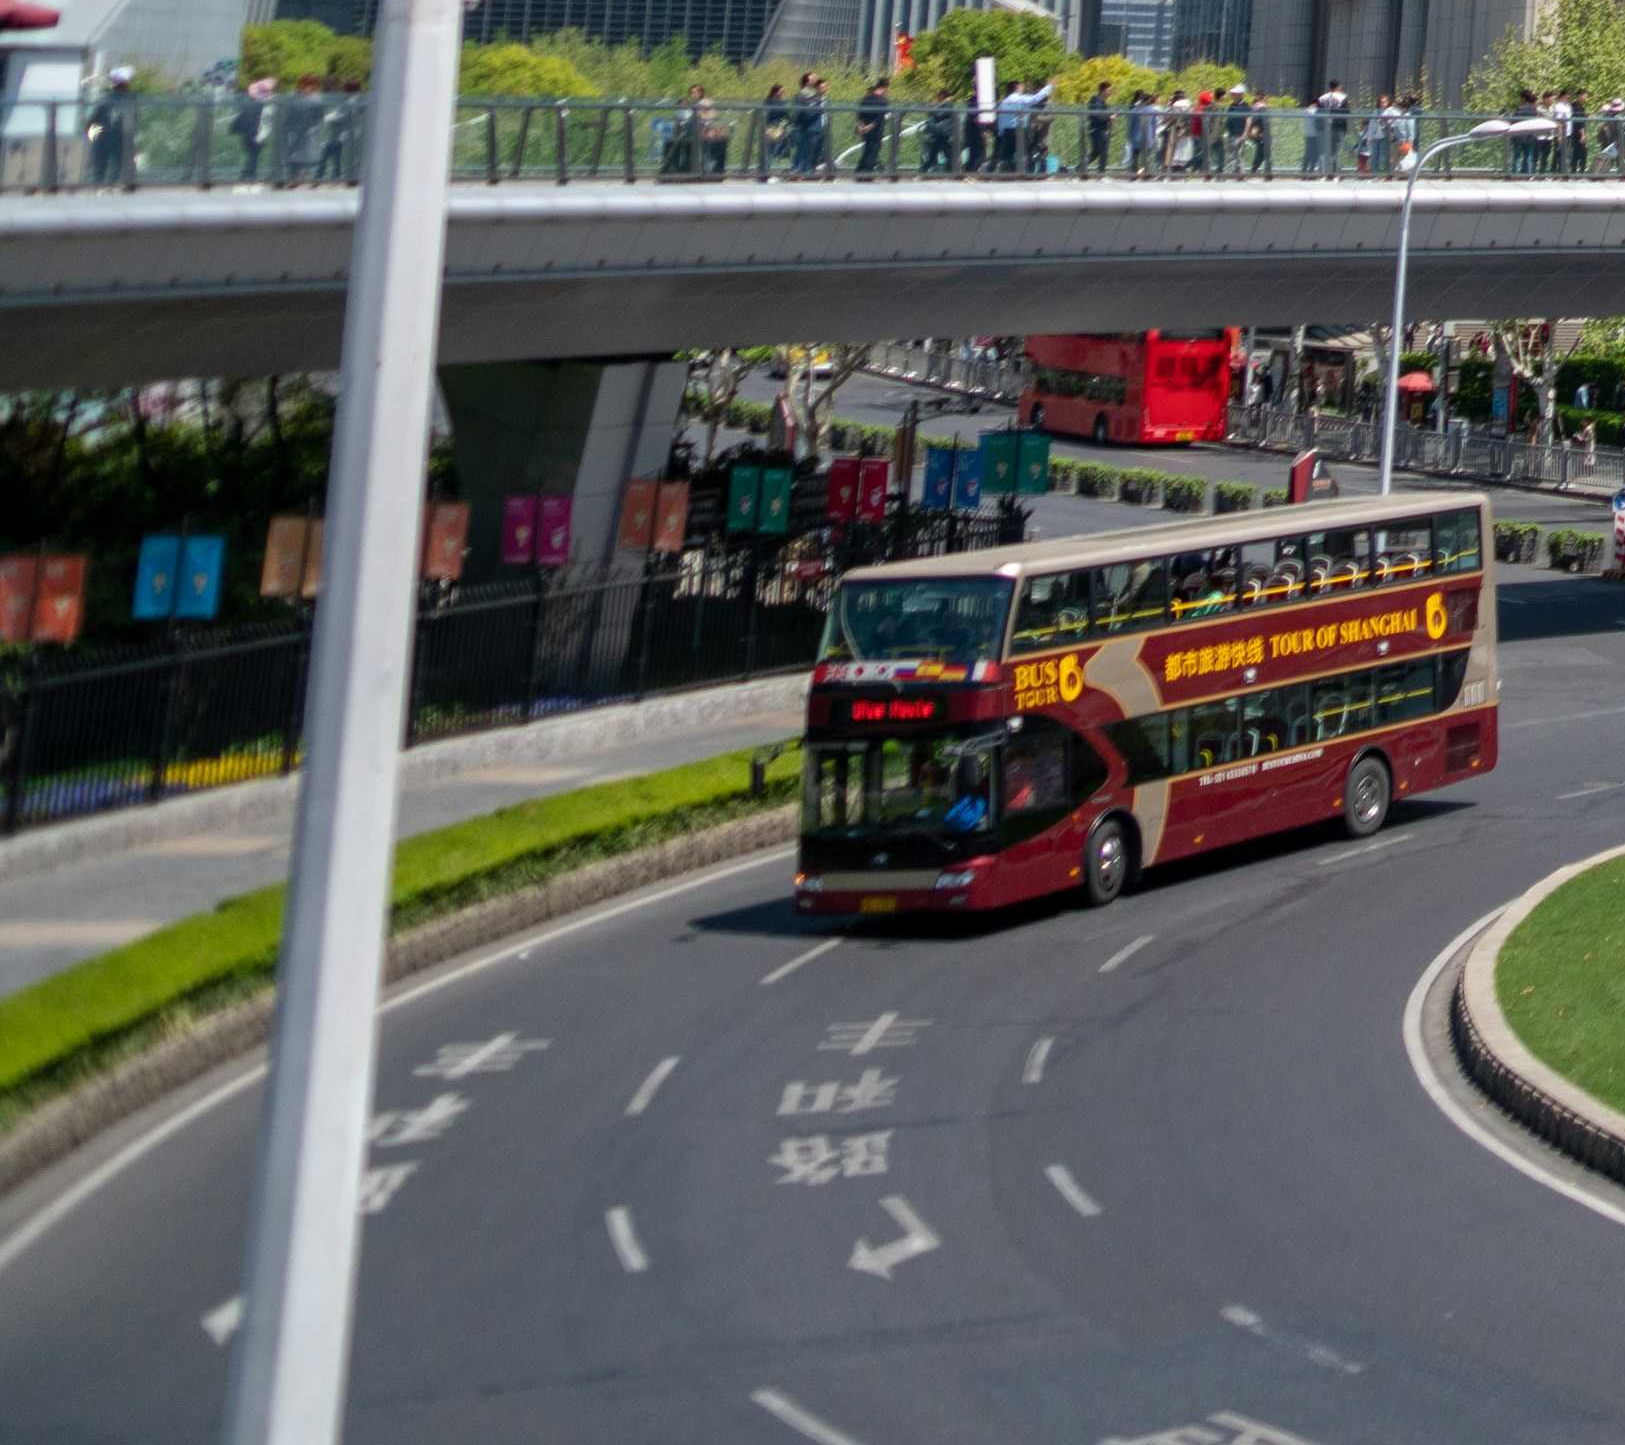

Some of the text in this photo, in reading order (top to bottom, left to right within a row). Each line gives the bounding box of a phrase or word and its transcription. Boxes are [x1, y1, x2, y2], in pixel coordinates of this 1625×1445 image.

[1164, 634, 1265, 683] 都市旅游快线
[1269, 628, 1315, 659] TOUR
[1316, 623, 1339, 648] OF
[1339, 608, 1419, 646] SHANGHAI
[1014, 659, 1058, 692] BUS
[1014, 687, 1058, 711] TOUR
